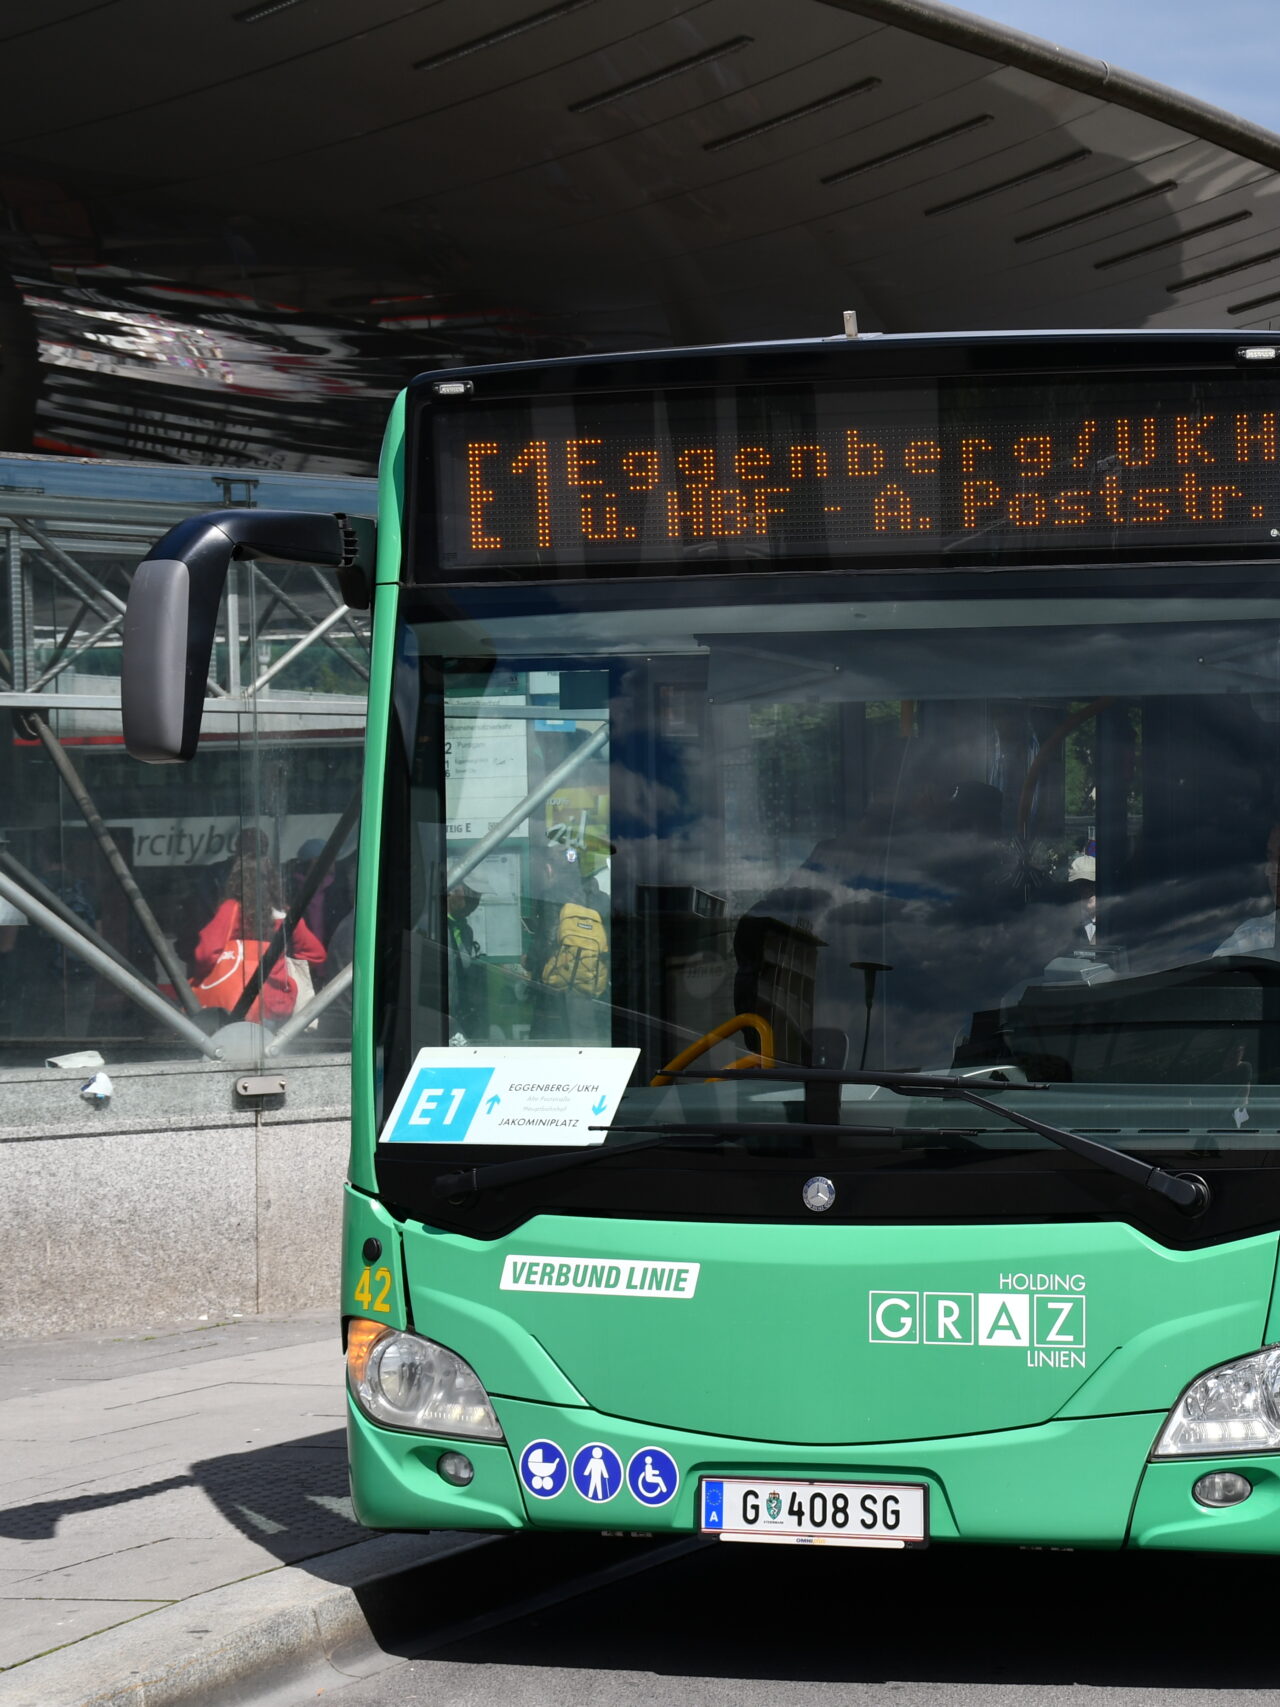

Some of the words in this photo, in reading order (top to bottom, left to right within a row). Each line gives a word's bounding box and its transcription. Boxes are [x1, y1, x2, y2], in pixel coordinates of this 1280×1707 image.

[468, 441, 550, 549] E1
[873, 483, 931, 531] A.
[963, 472, 1264, 529] Poststr.
[465, 822, 472, 833] E
[508, 1083, 600, 1094] EGGENBERG/UKH
[407, 1087, 466, 1126] E1
[498, 1117, 580, 1128] JAKOMINIPLATZ
[354, 1266, 392, 1313] 42
[512, 1261, 621, 1289] VERBUND
[626, 1266, 690, 1292] LINIE
[999, 1273, 1086, 1292] HOLDING
[875, 1296, 1076, 1343] GRAZ
[1027, 1350, 1086, 1368] LINIEN
[709, 1511, 719, 1522] A
[742, 1489, 760, 1525] G
[788, 1491, 850, 1528] 408
[860, 1493, 901, 1530] SG
